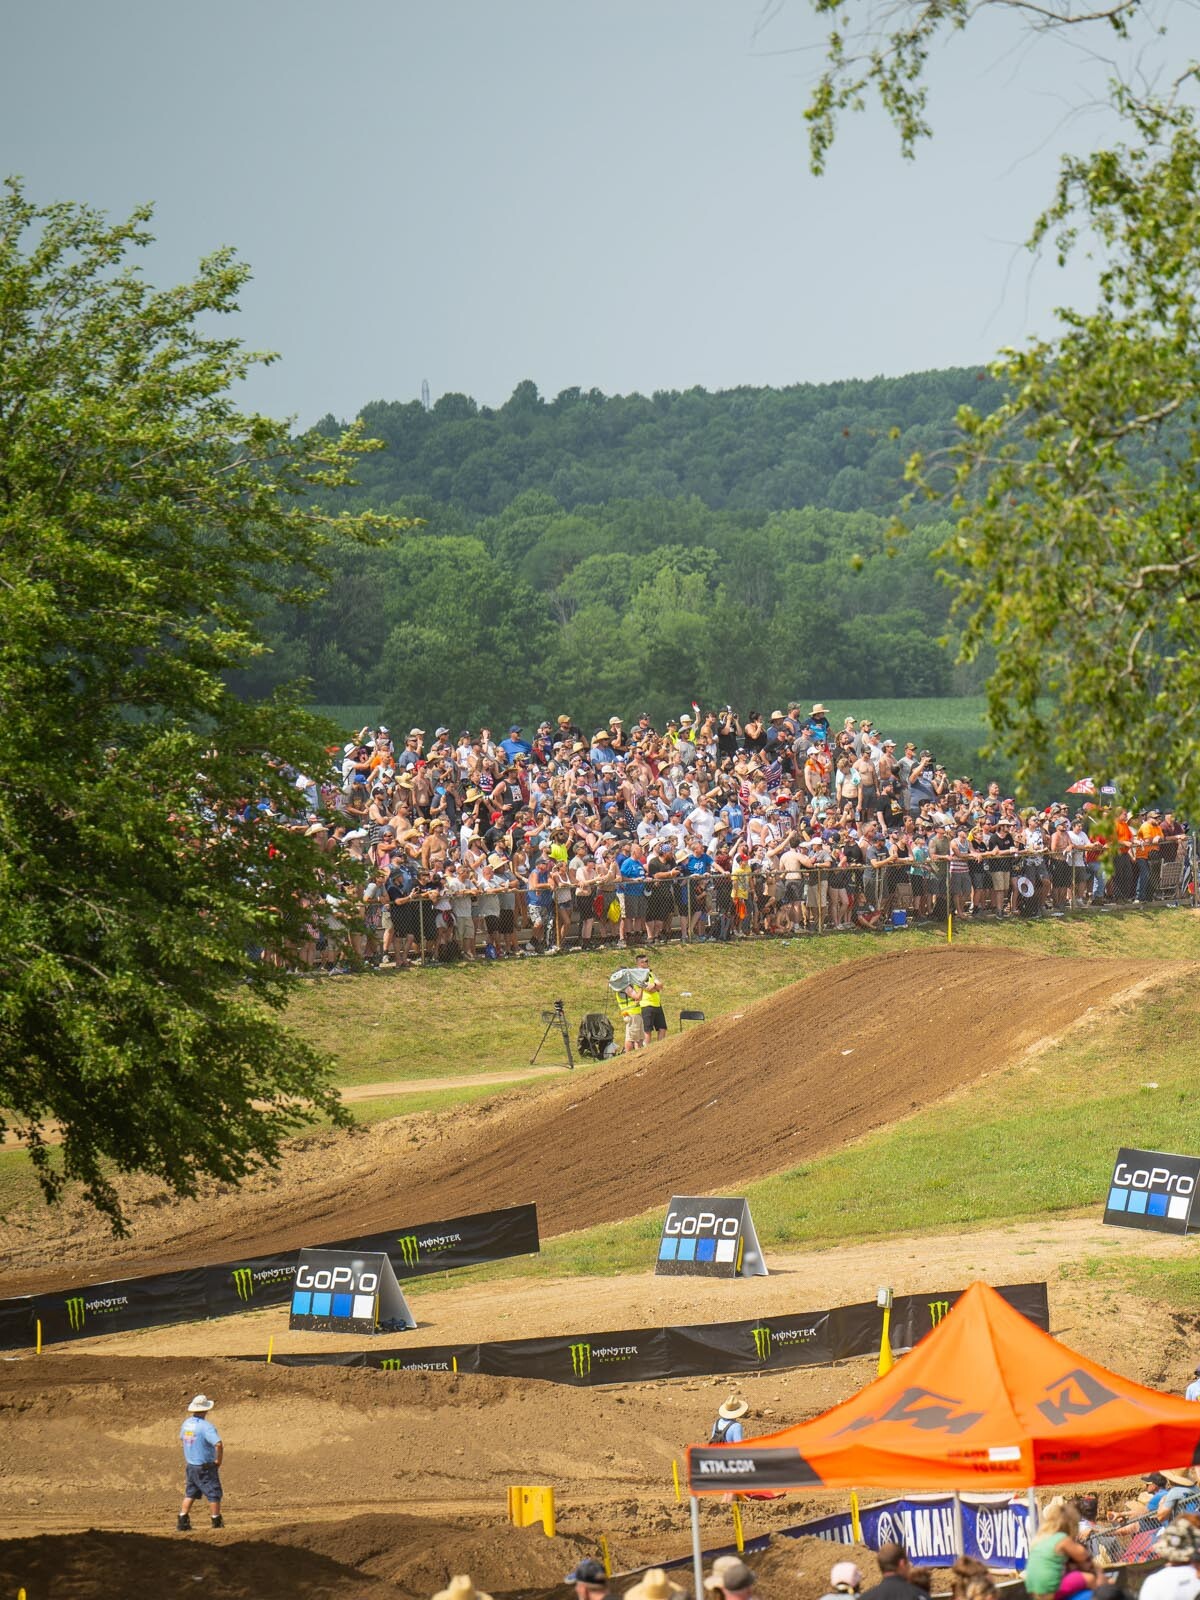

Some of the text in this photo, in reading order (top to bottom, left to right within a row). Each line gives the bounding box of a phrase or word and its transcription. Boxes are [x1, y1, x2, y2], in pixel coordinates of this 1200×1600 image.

[1113, 1163, 1194, 1194] GoPro
[665, 1212, 739, 1236] GoPro
[419, 1233, 462, 1249] MONSTER
[253, 1265, 297, 1281] MONSTER
[85, 1296, 128, 1311] MONSTER
[771, 1328, 817, 1342] MONSTER
[592, 1345, 638, 1358] MONSTER
[402, 1362, 448, 1371] MONSTER
[699, 1459, 756, 1474] KTM.COM
